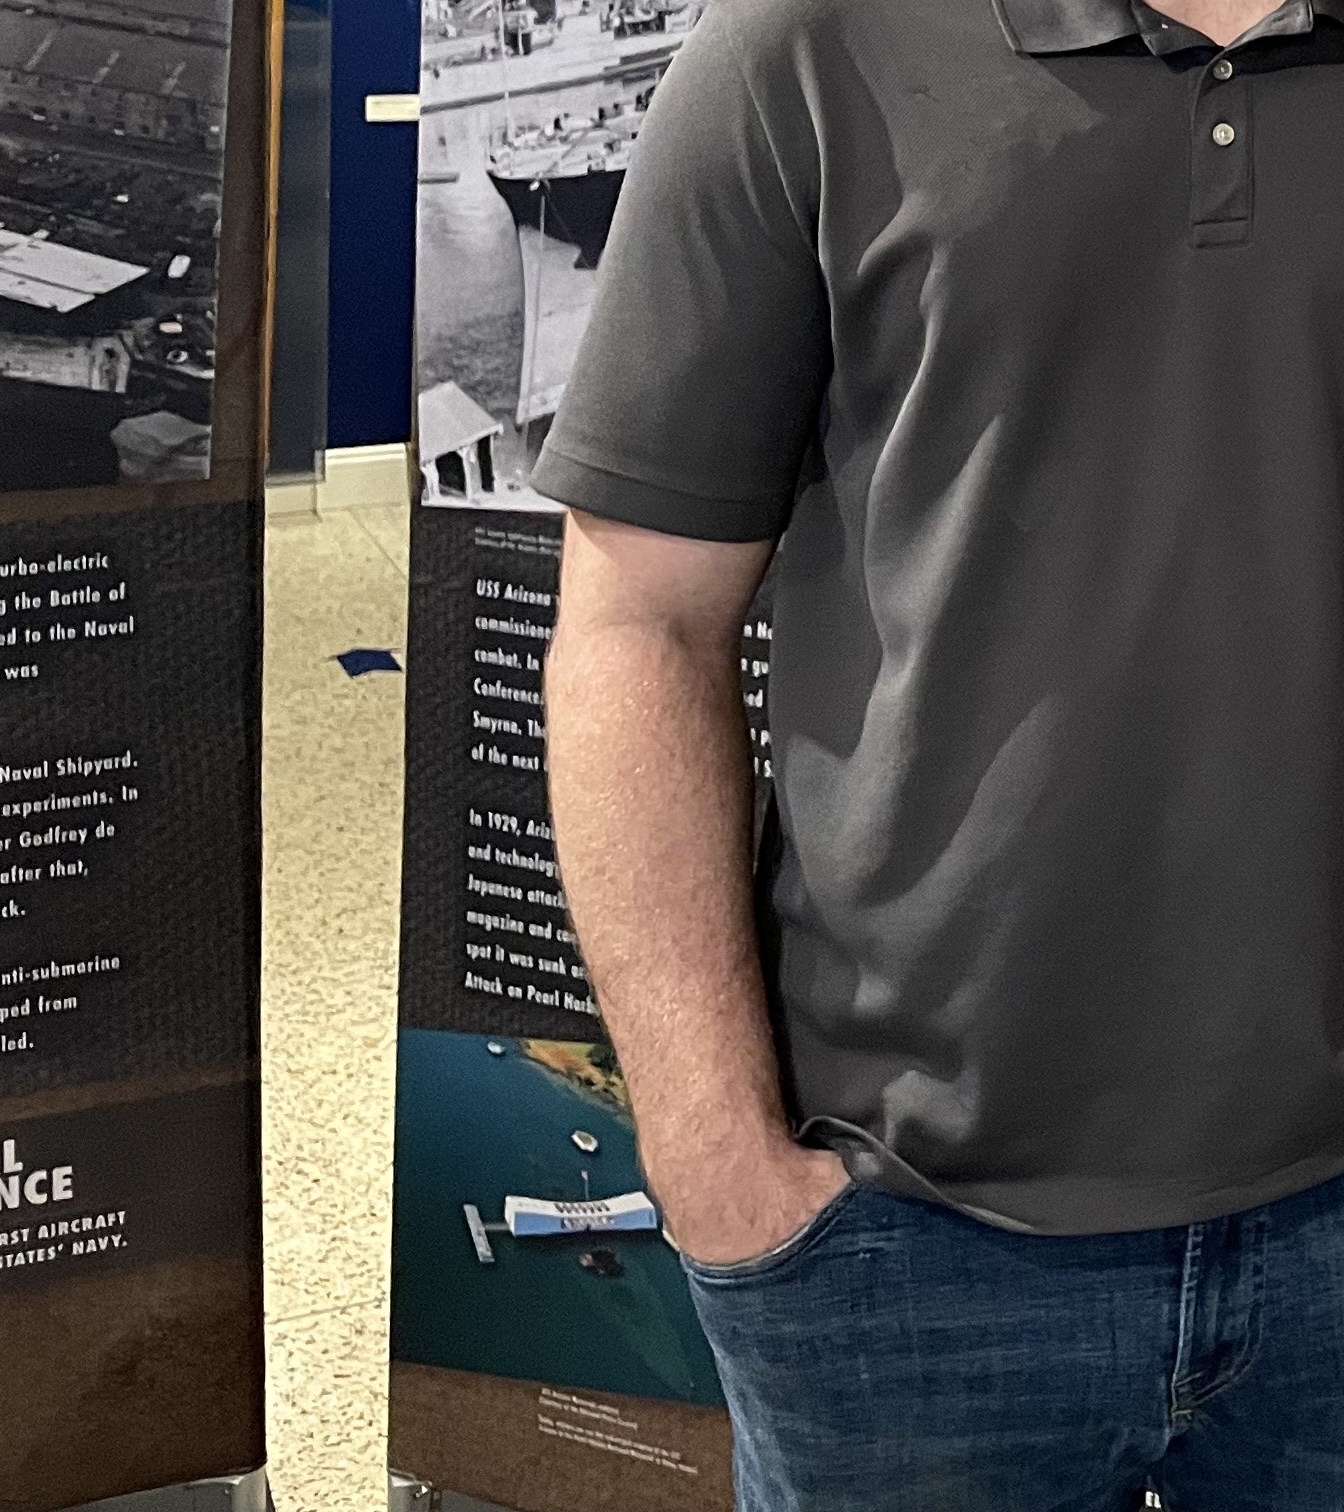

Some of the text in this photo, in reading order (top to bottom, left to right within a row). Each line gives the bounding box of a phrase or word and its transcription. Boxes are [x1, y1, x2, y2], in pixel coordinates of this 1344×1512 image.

[4, 664, 38, 680] was
[0, 749, 138, 783] Naval Shipyard.
[19, 820, 115, 847] Godfrey de
[38, 1210, 125, 1239] AIRCRAFT
[72, 1234, 128, 1255] NAVY.
